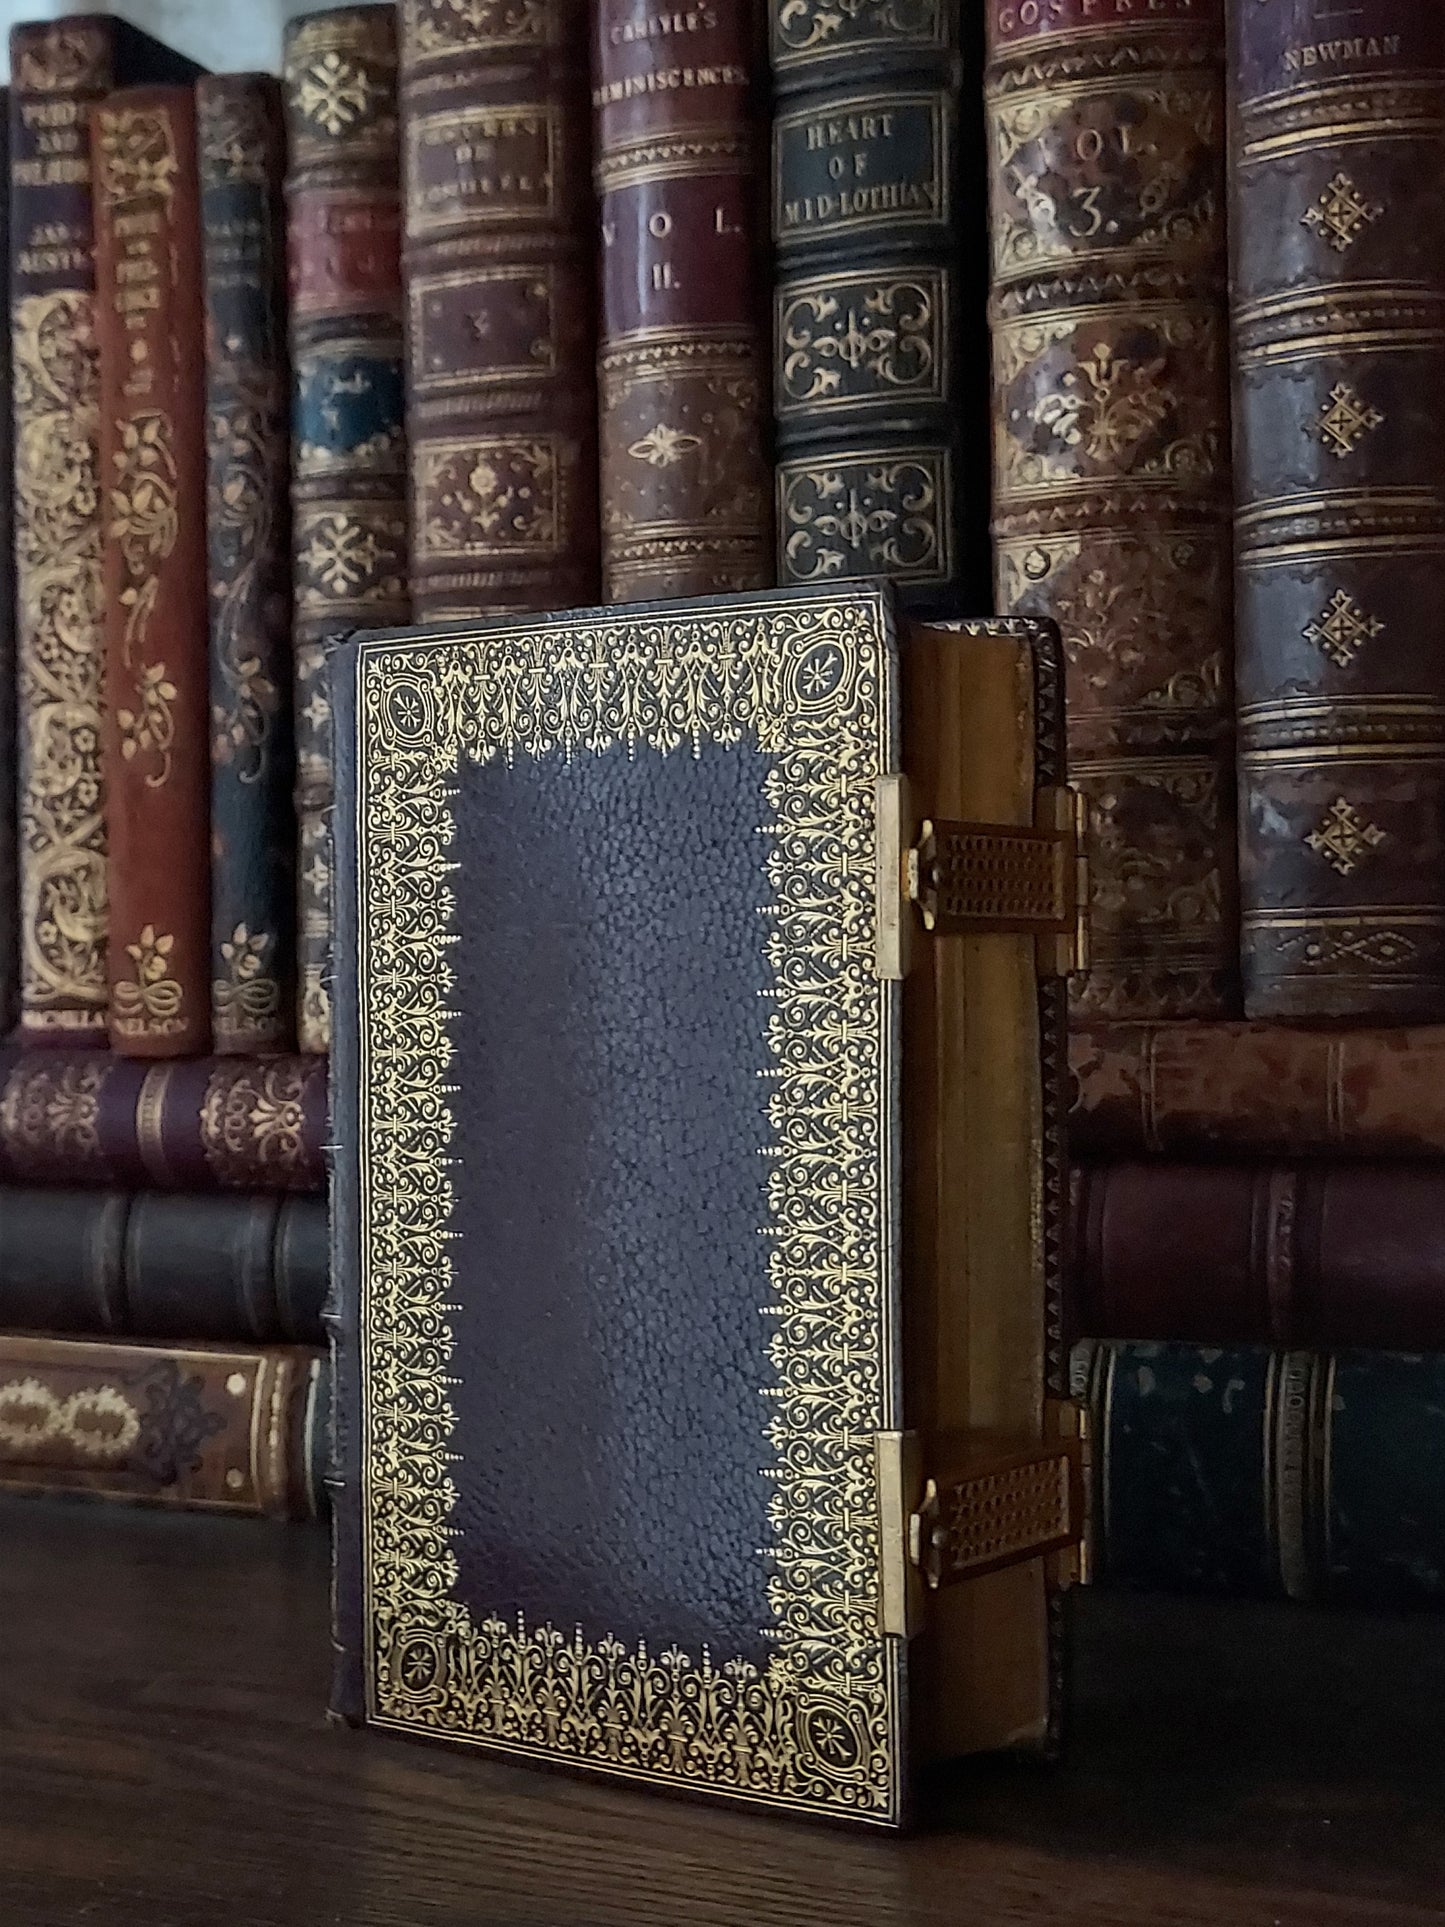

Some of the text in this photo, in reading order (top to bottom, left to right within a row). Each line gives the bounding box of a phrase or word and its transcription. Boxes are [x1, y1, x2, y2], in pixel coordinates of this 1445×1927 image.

[1282, 34, 1401, 71] NEWMAN
[807, 113, 893, 150] HEART
[829, 152, 868, 181] OF
